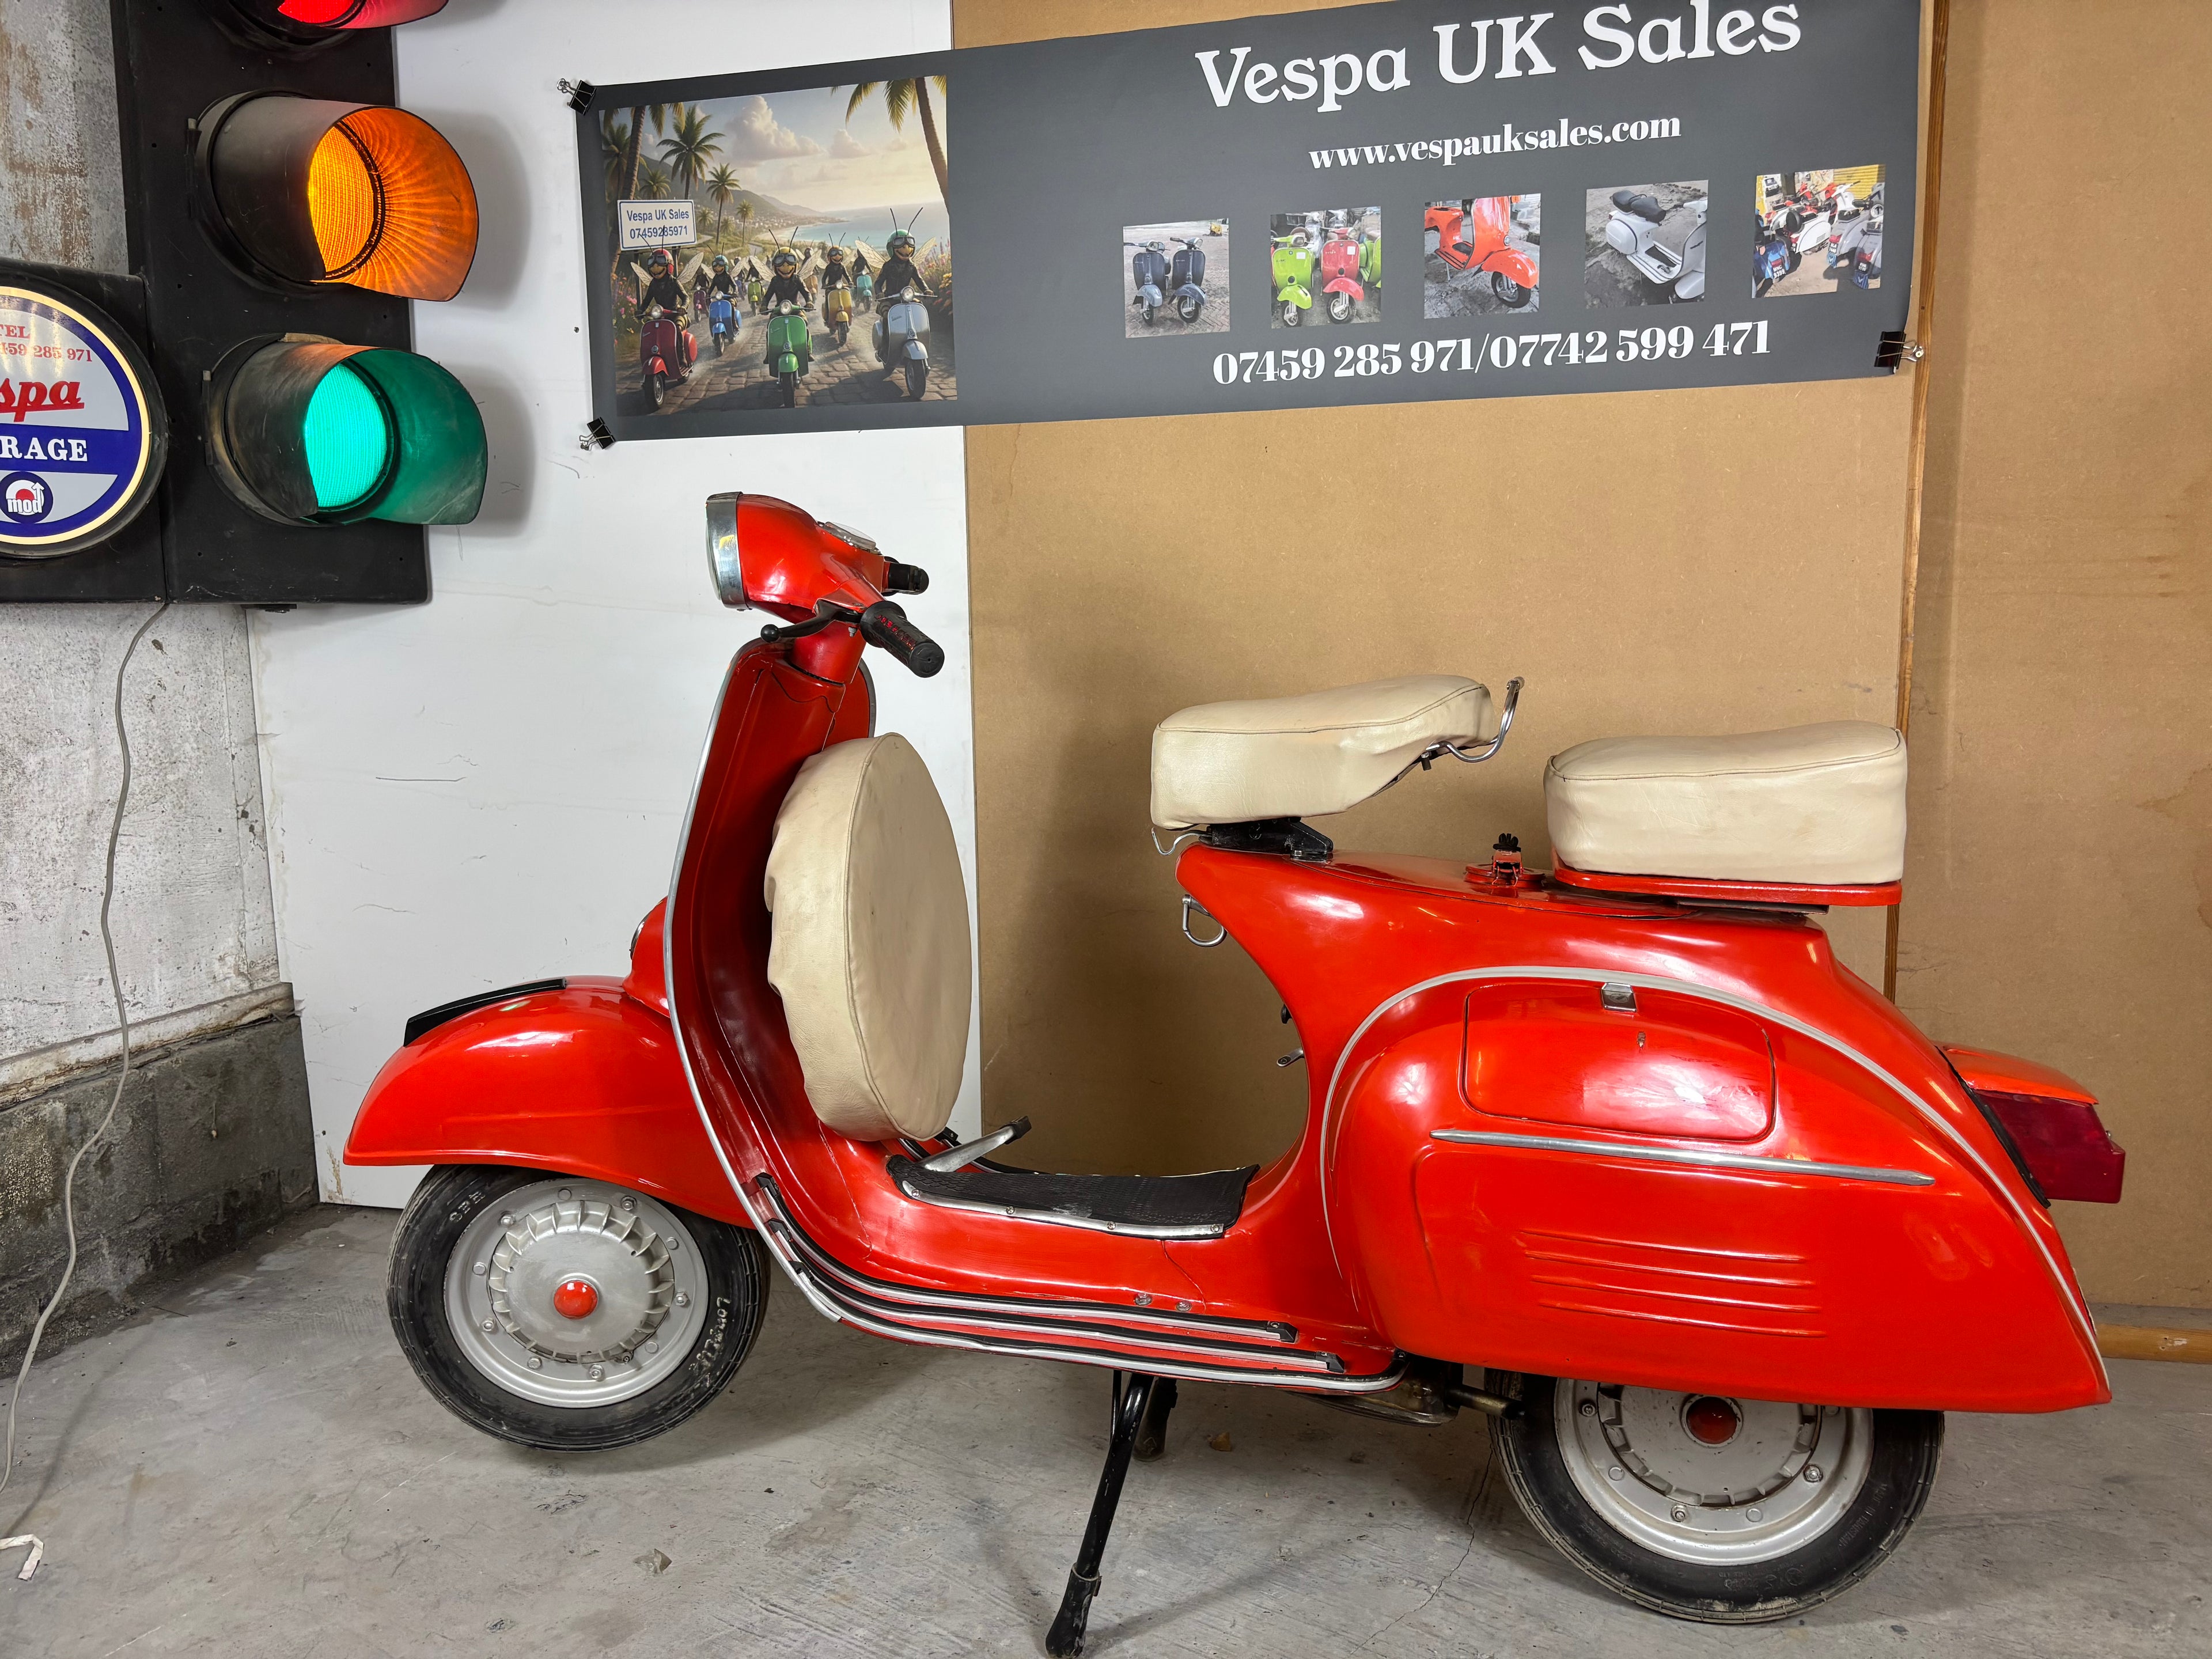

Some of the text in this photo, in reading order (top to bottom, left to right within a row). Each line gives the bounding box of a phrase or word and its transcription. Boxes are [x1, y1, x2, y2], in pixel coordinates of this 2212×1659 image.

[1195, 0, 1801, 113] Vespa UK Sales
[1308, 118, 1681, 169] www.vespauksales.com
[627, 209, 690, 224] Vespa UK Sales
[630, 225, 688, 239] 07459285971
[33, 346, 62, 359] 285
[67, 348, 93, 362] 971
[1213, 320, 1770, 384] 07459 285 971/07742 599 471
[7, 491, 44, 513] mod
